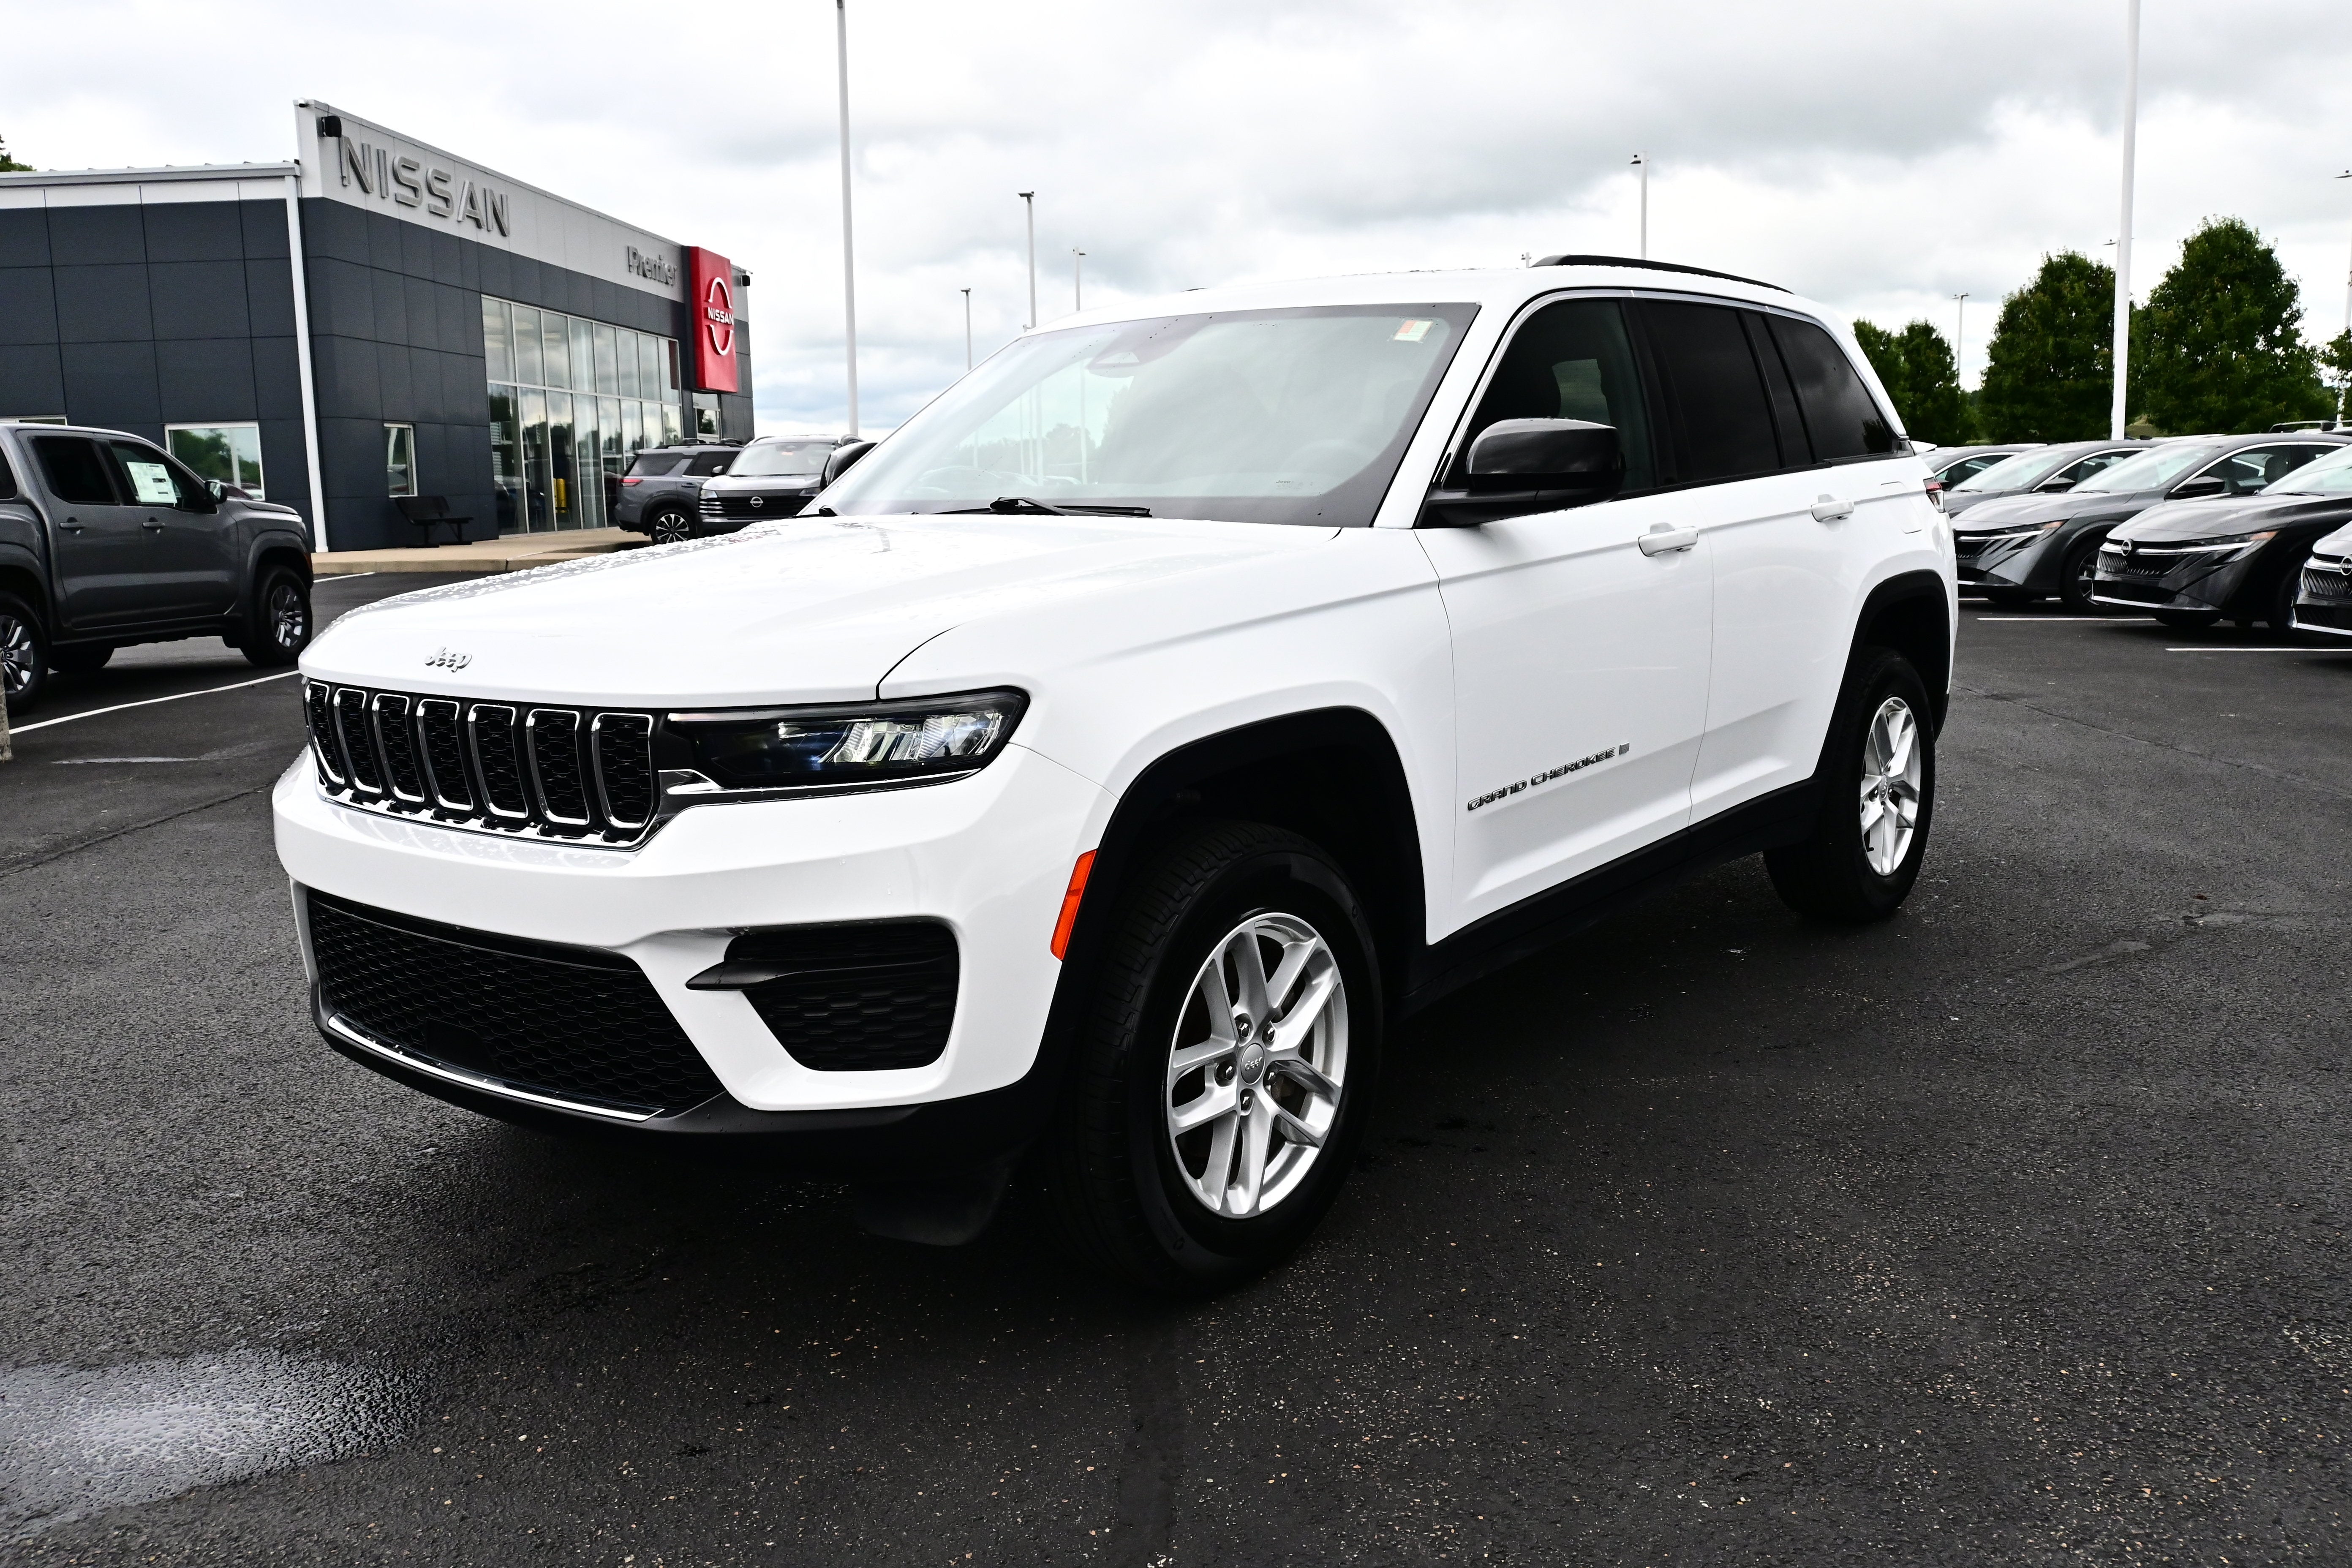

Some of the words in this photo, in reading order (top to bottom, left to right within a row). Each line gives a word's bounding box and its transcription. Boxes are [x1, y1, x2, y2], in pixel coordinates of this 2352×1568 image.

[340, 135, 510, 237] NISSAN
[627, 245, 678, 286] Premier
[708, 307, 734, 325] NISSAN
[424, 646, 472, 672] Jeep
[1467, 779, 1527, 811] GRAND
[1531, 747, 1616, 786] CHEROKEE
